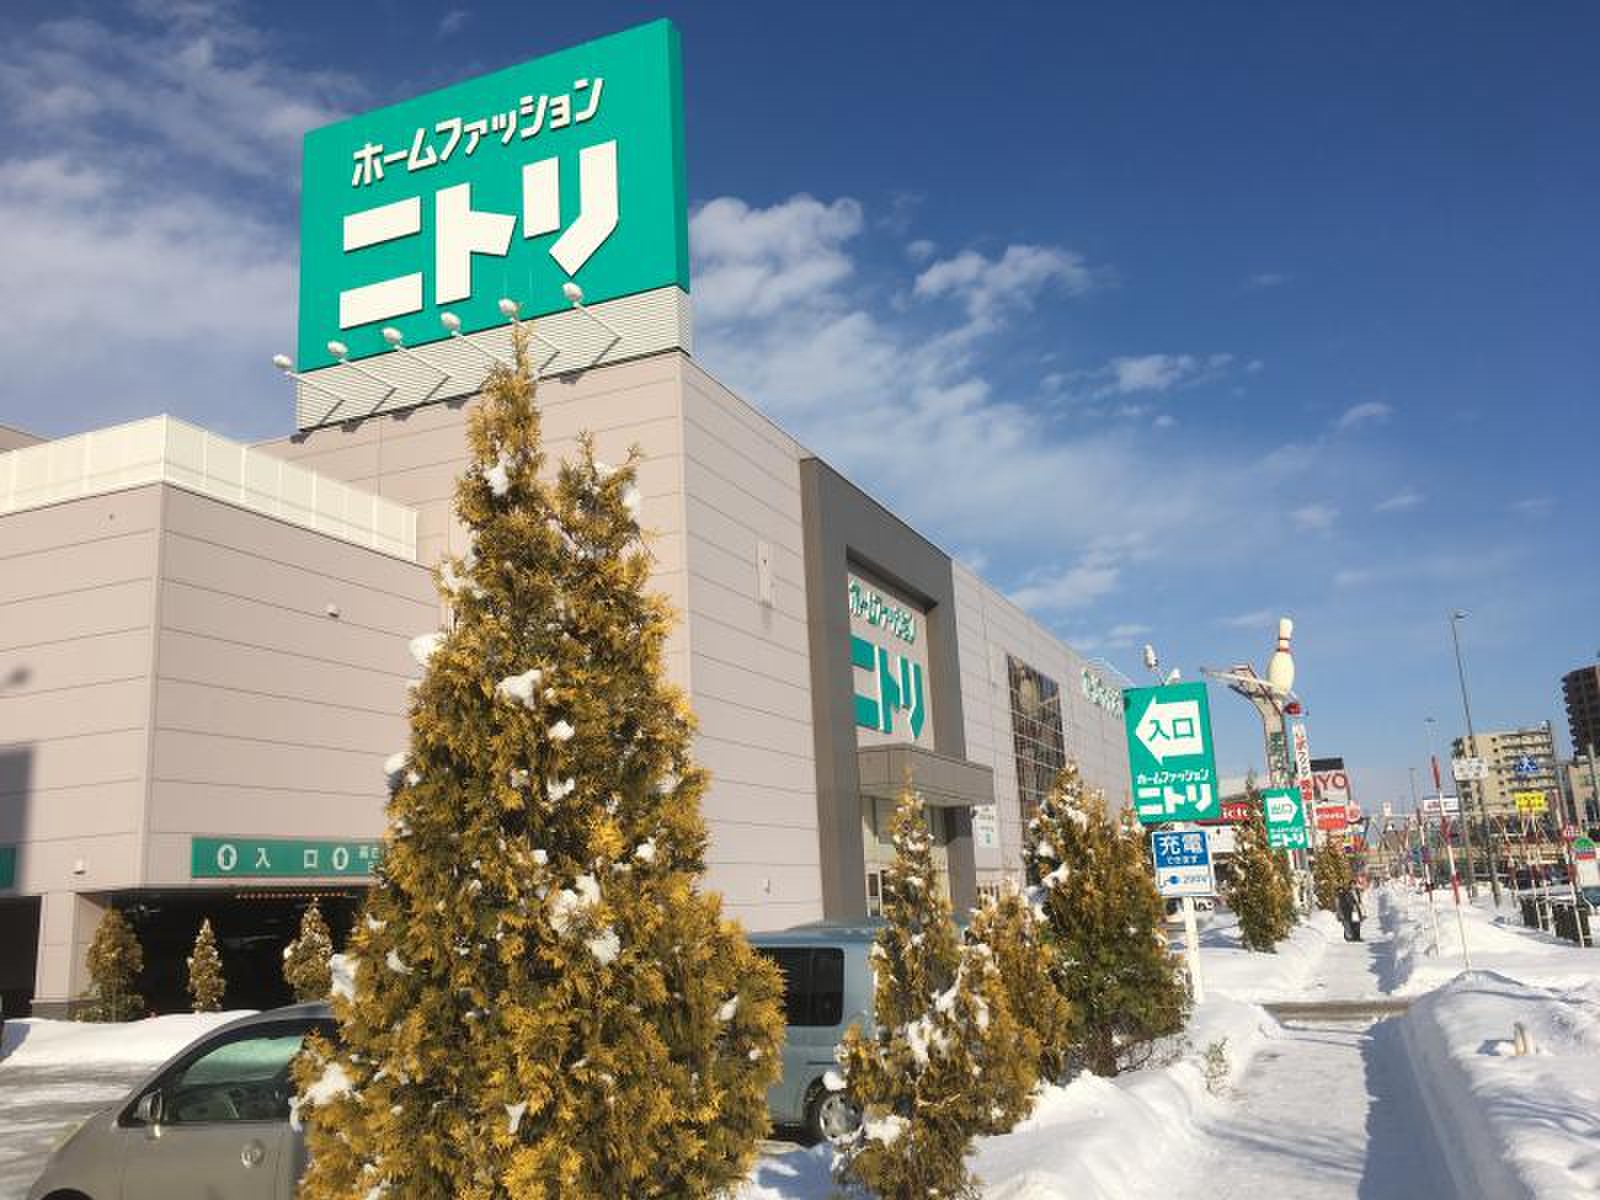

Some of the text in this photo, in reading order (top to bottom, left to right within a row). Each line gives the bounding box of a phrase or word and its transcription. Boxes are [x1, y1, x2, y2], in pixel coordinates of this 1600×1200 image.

[351, 77, 605, 188] ホームファッション
[338, 139, 620, 331] ニトリ
[850, 634, 925, 741] ニトリ
[1148, 717, 1195, 742] 入口
[1137, 783, 1212, 814] ニトリ
[1157, 833, 1203, 857] 充電
[1271, 831, 1304, 847] ニトリ
[255, 846, 318, 869] 入口
